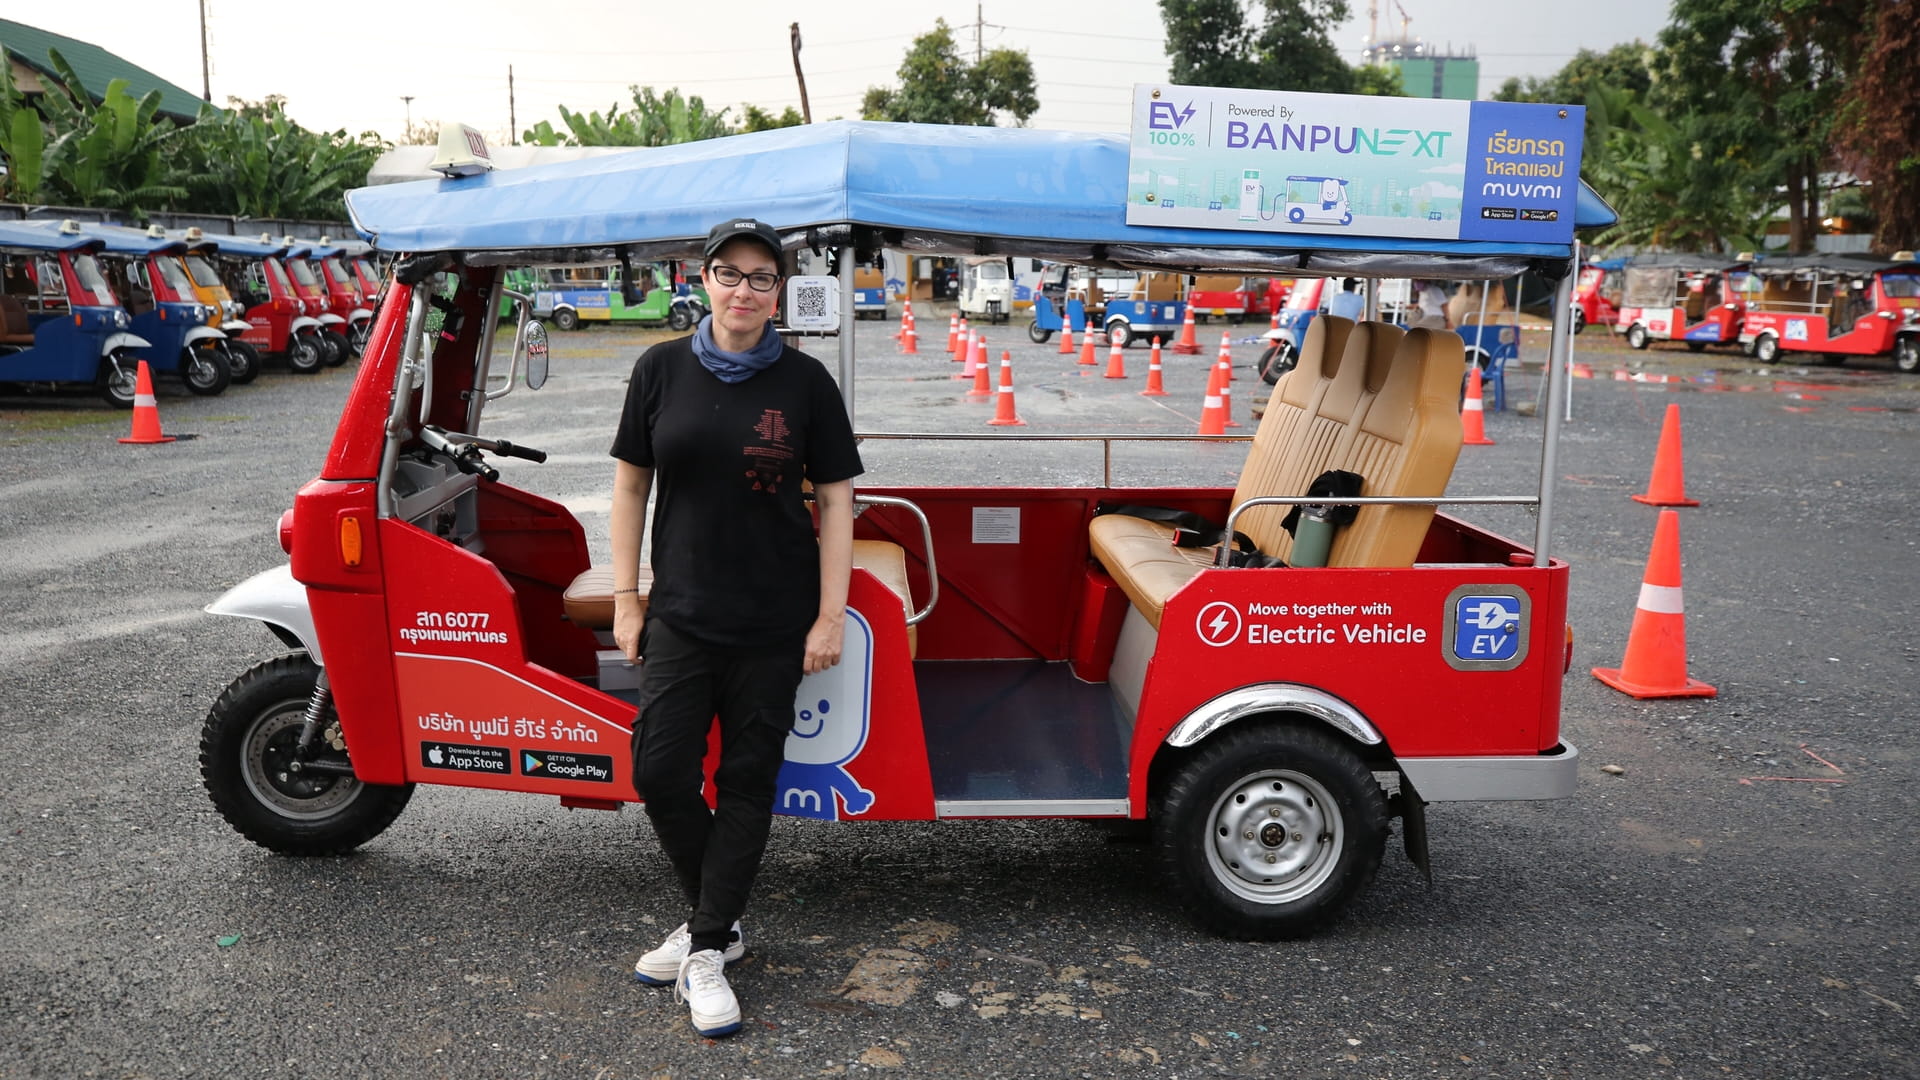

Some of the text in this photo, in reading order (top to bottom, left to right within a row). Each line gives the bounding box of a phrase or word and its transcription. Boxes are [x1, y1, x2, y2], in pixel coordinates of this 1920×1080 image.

[1228, 103, 1294, 121] Powered By
[1149, 131, 1195, 147] 100%
[1487, 129, 1565, 156] เรียกรถ
[1485, 157, 1564, 178] โหลดแอป
[1482, 182, 1562, 199] muvmi
[1248, 602, 1392, 618] Move together with
[445, 611, 489, 629] 6077
[400, 628, 508, 645] กรุงเทพมหานคร
[1248, 624, 1427, 644] Electric Vehicle
[1471, 634, 1508, 654] EV
[418, 711, 465, 733] บริษัท
[469, 715, 509, 740] มูฟมี
[550, 719, 598, 743] จำกัด
[448, 746, 480, 757] Download
[491, 750, 502, 758] the
[547, 754, 559, 762] GET
[449, 755, 504, 770] App Store
[547, 762, 607, 779] Google Play
